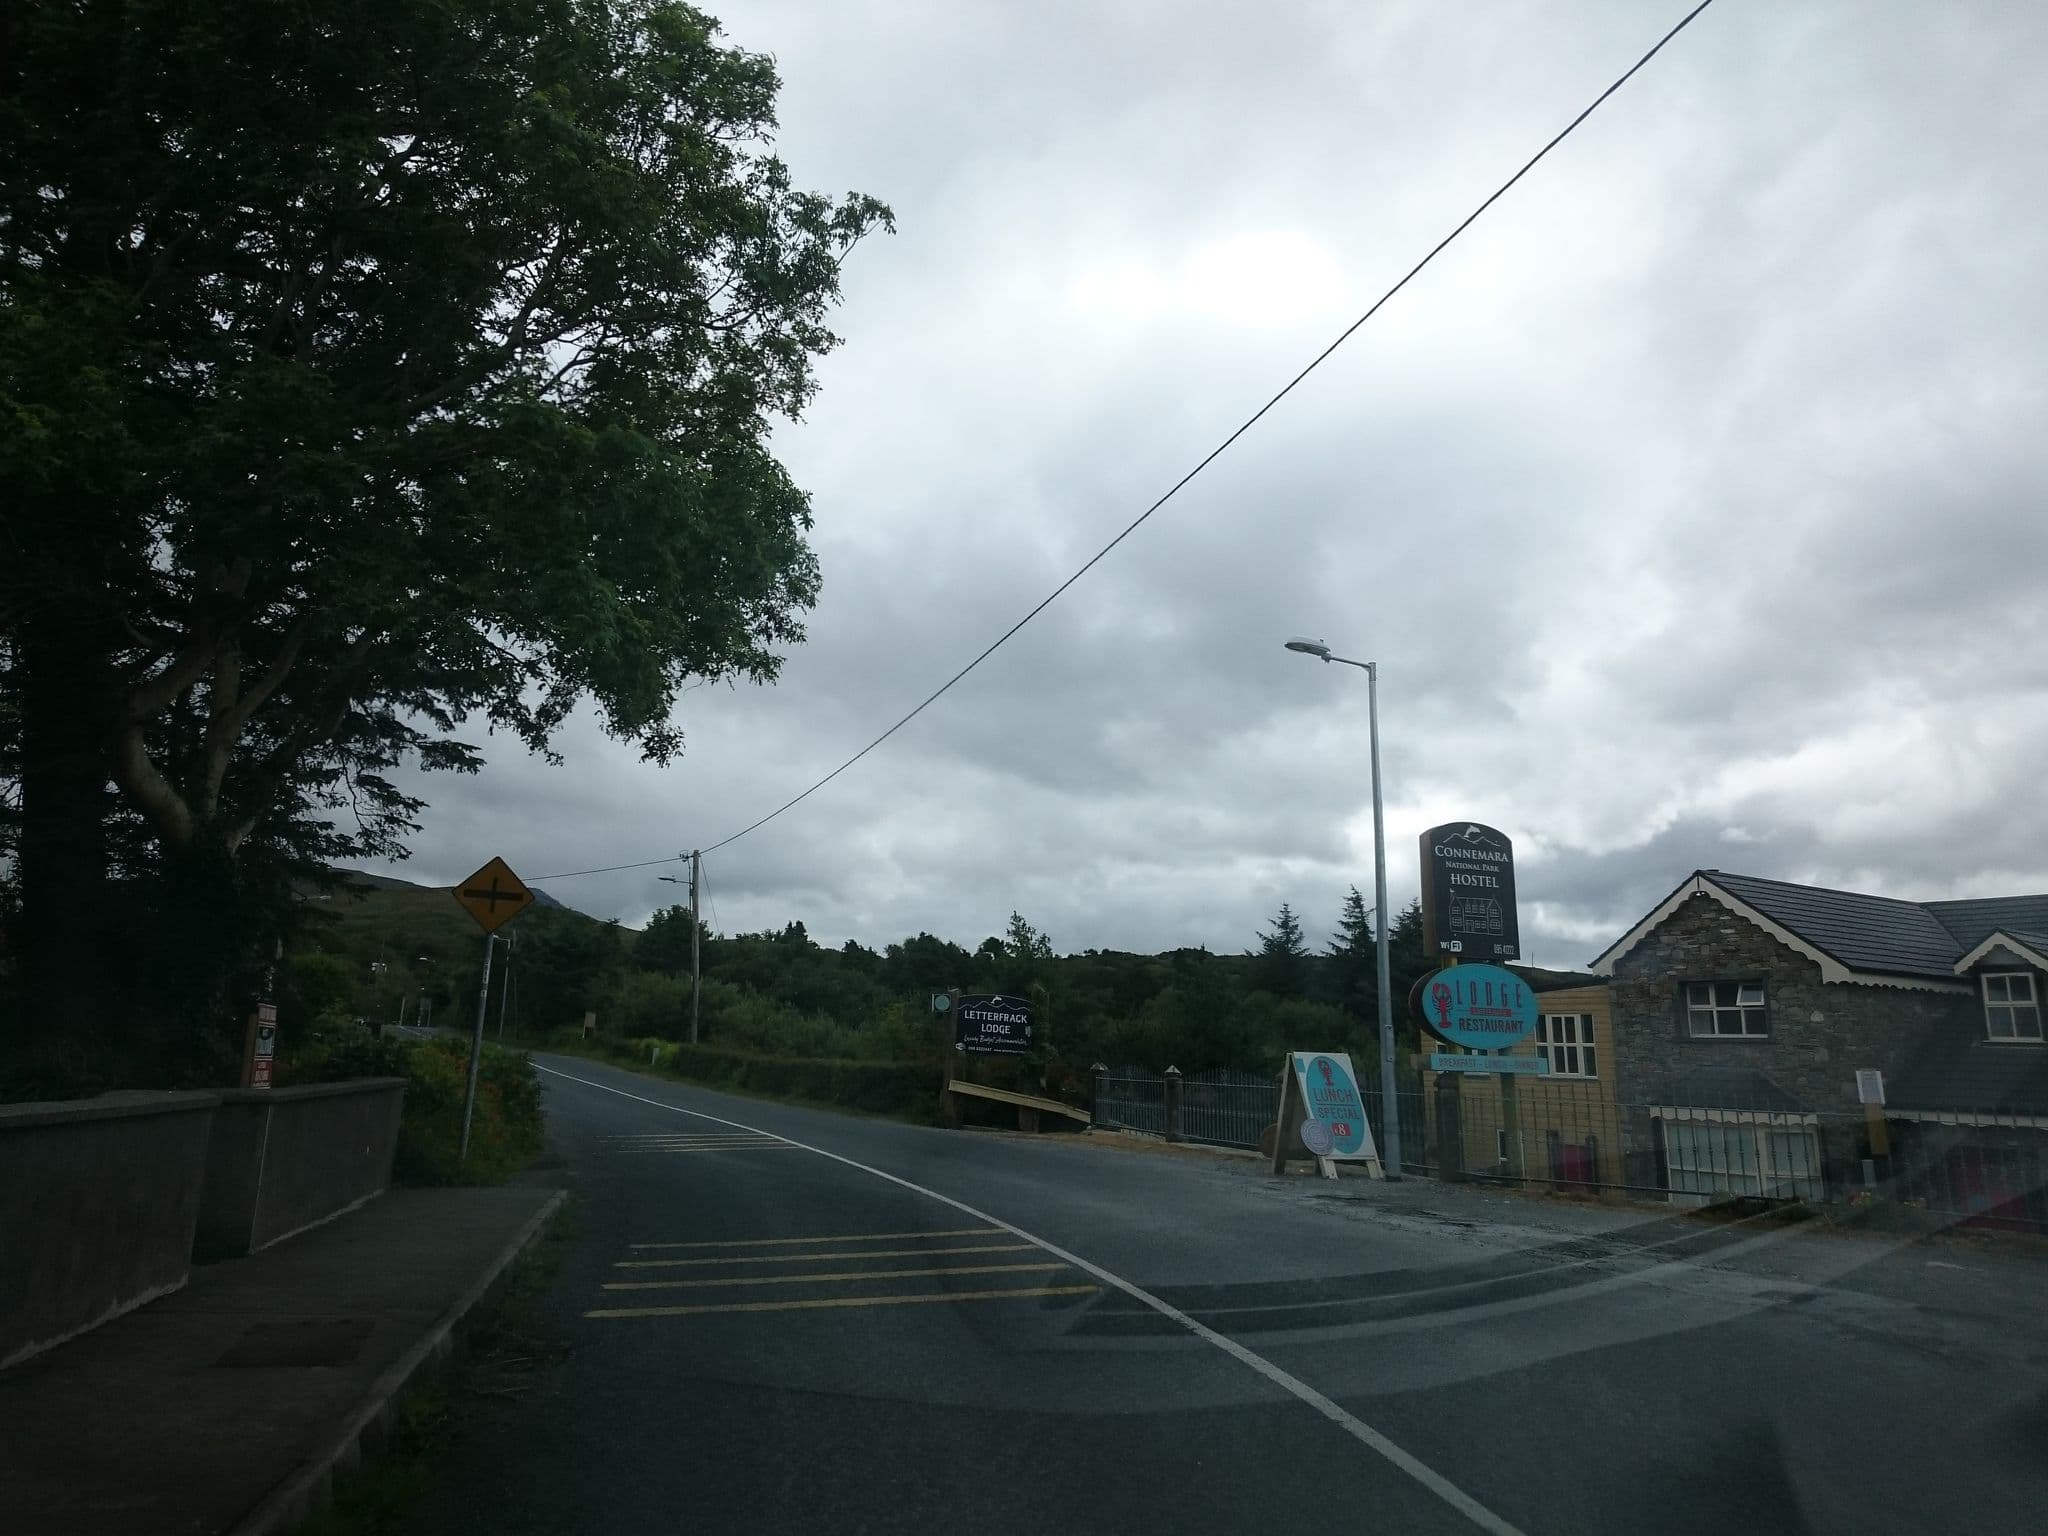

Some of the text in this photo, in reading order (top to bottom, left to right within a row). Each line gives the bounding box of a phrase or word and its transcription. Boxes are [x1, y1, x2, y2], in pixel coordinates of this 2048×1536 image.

[1435, 845, 1509, 863] CONNEMARA
[1446, 861, 1500, 873] NATIONAL PARK
[1450, 873, 1499, 888] HOSTEL
[1456, 979, 1522, 1008] LODGE
[964, 1010, 1027, 1023] LETTERFRACK
[981, 1023, 1011, 1034] LODGE
[1459, 1018, 1524, 1034] RESTAURANT
[1313, 1087, 1354, 1103] LUNCH
[1318, 1107, 1360, 1120] SPECIAL
